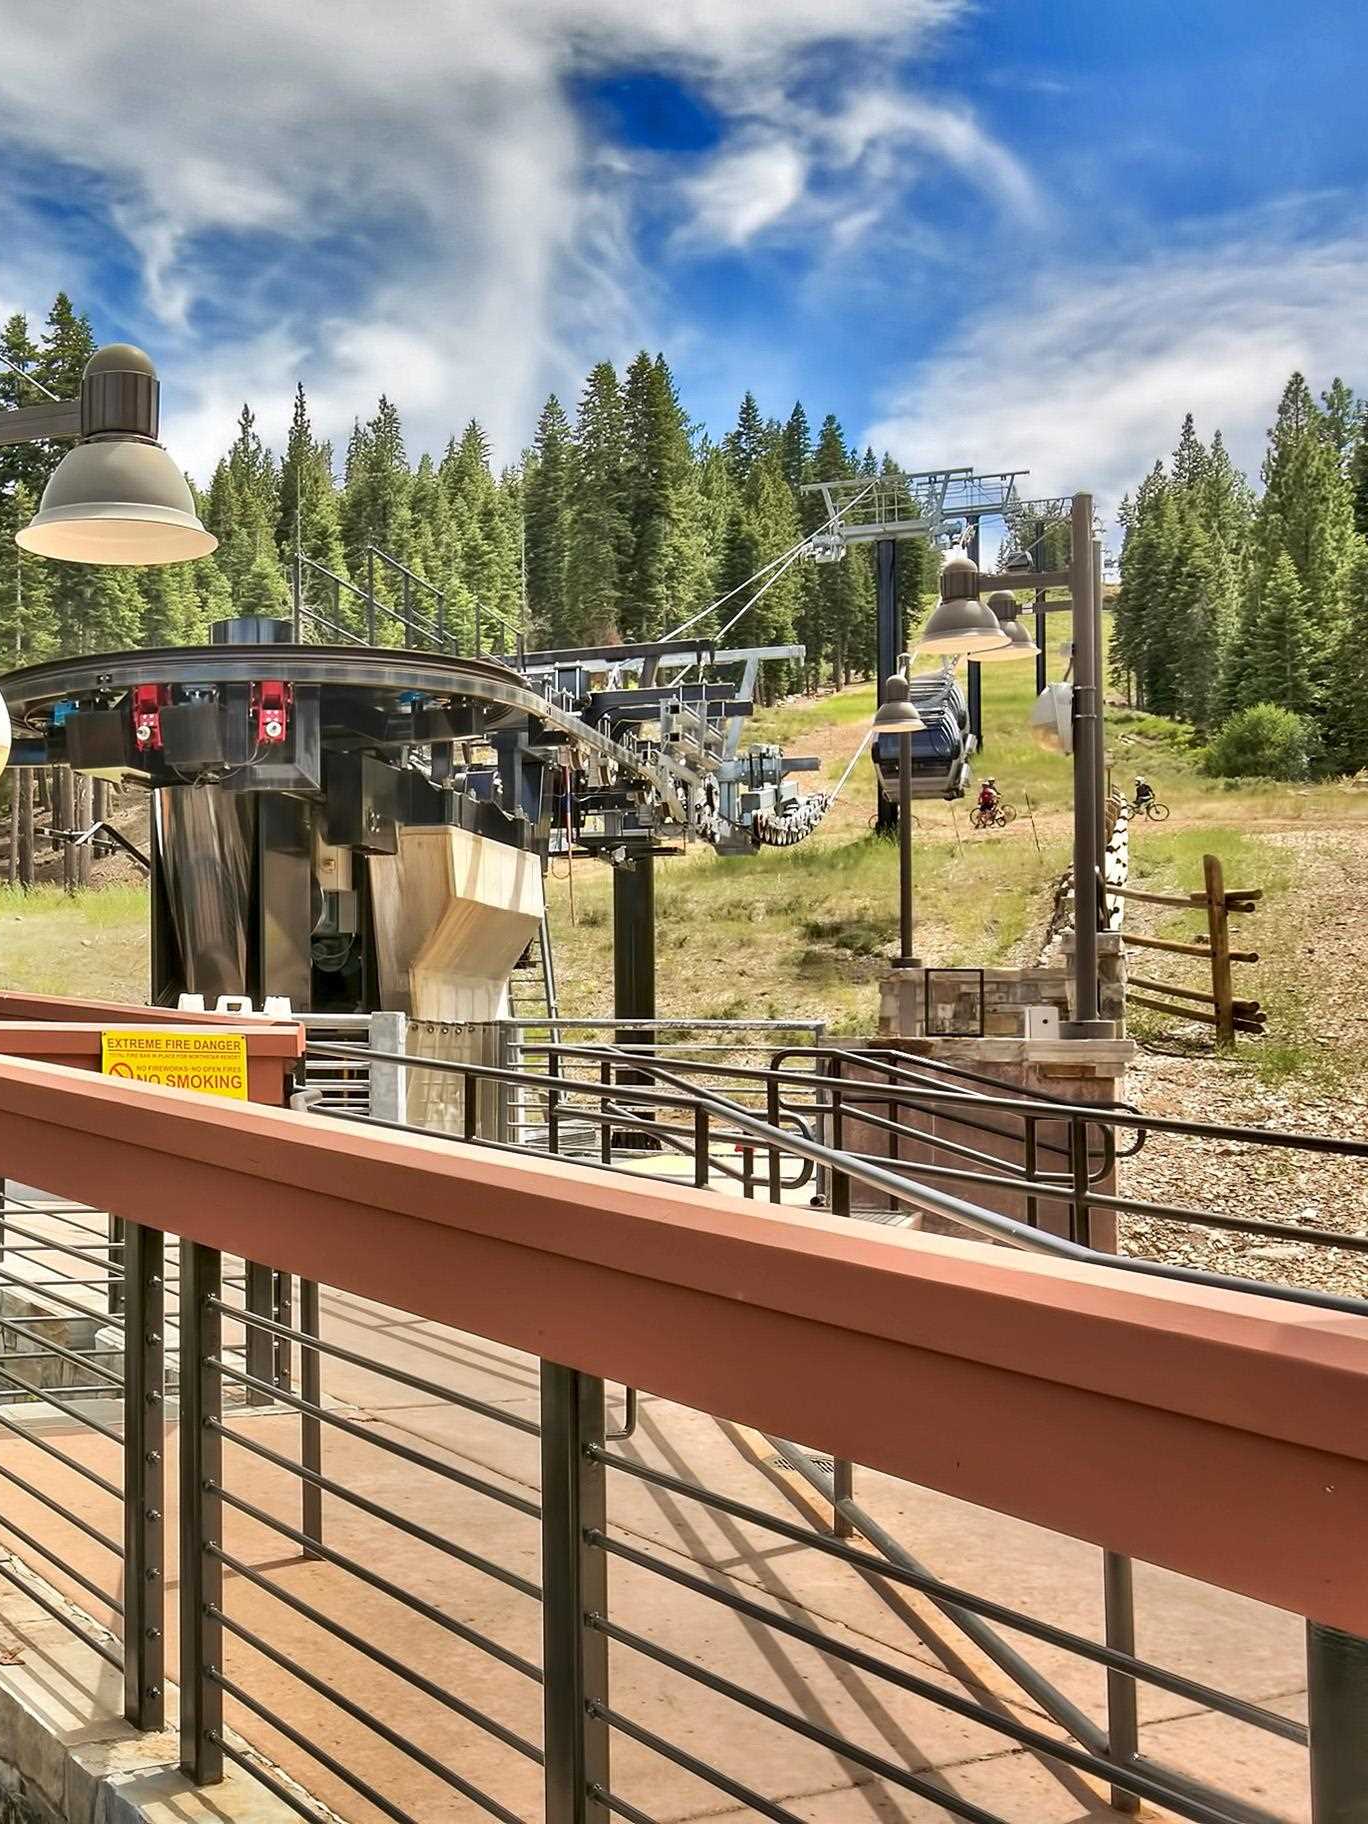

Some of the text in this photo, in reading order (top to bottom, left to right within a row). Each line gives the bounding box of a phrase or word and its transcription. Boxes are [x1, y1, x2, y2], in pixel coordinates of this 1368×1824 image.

[107, 1038, 241, 1051] EXTREME FIRE DANGER
[166, 1074, 242, 1089] SMOKING
